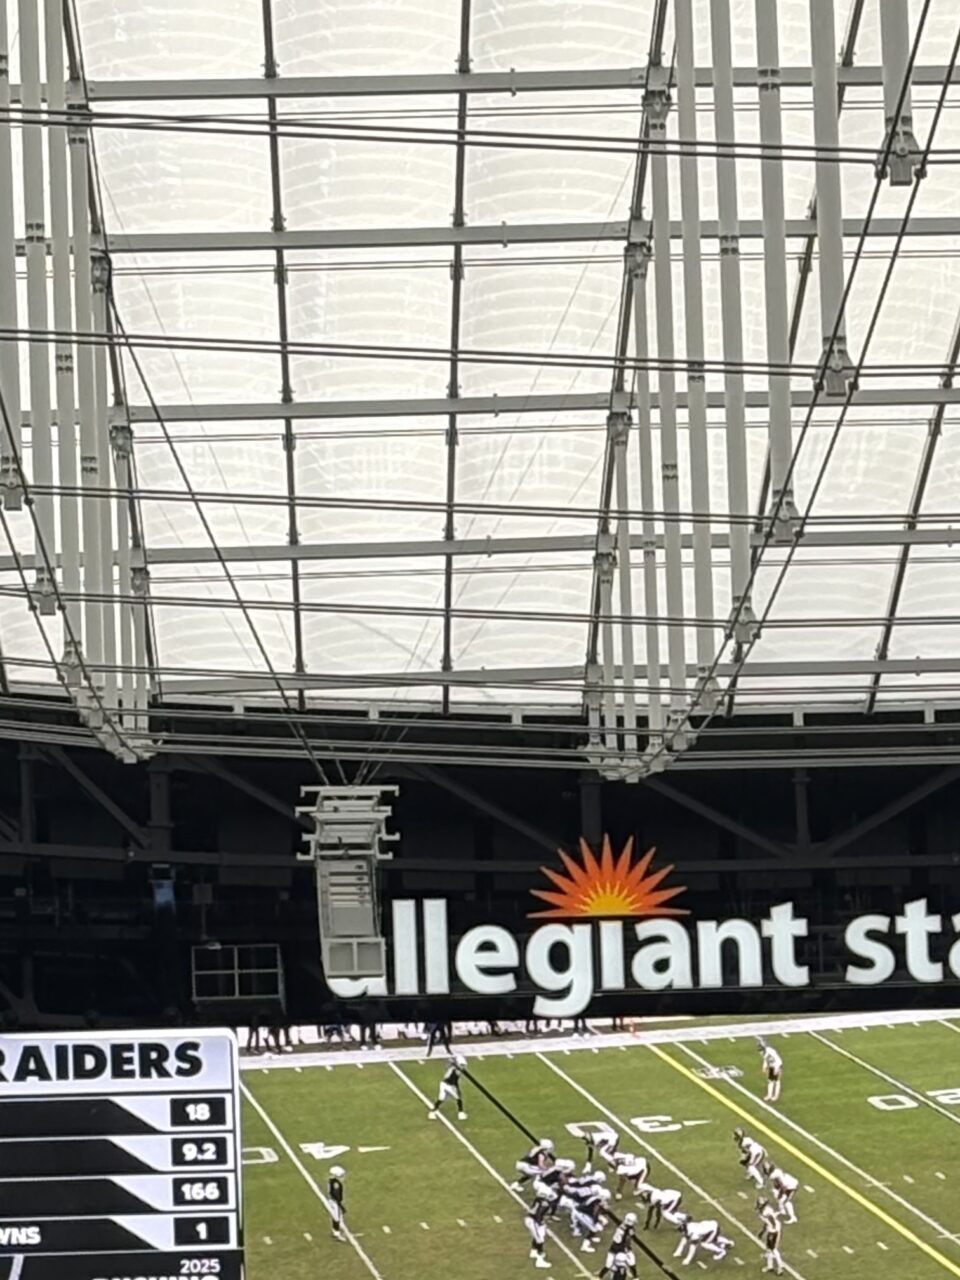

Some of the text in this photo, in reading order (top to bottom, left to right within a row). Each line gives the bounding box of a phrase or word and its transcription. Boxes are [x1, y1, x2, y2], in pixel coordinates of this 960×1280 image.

[328, 897, 809, 1018] llegiant
[185, 1104, 210, 1121] 18
[182, 1144, 217, 1161] 9.2
[196, 1223, 207, 1240] 1
[180, 1259, 221, 1273] 2025
